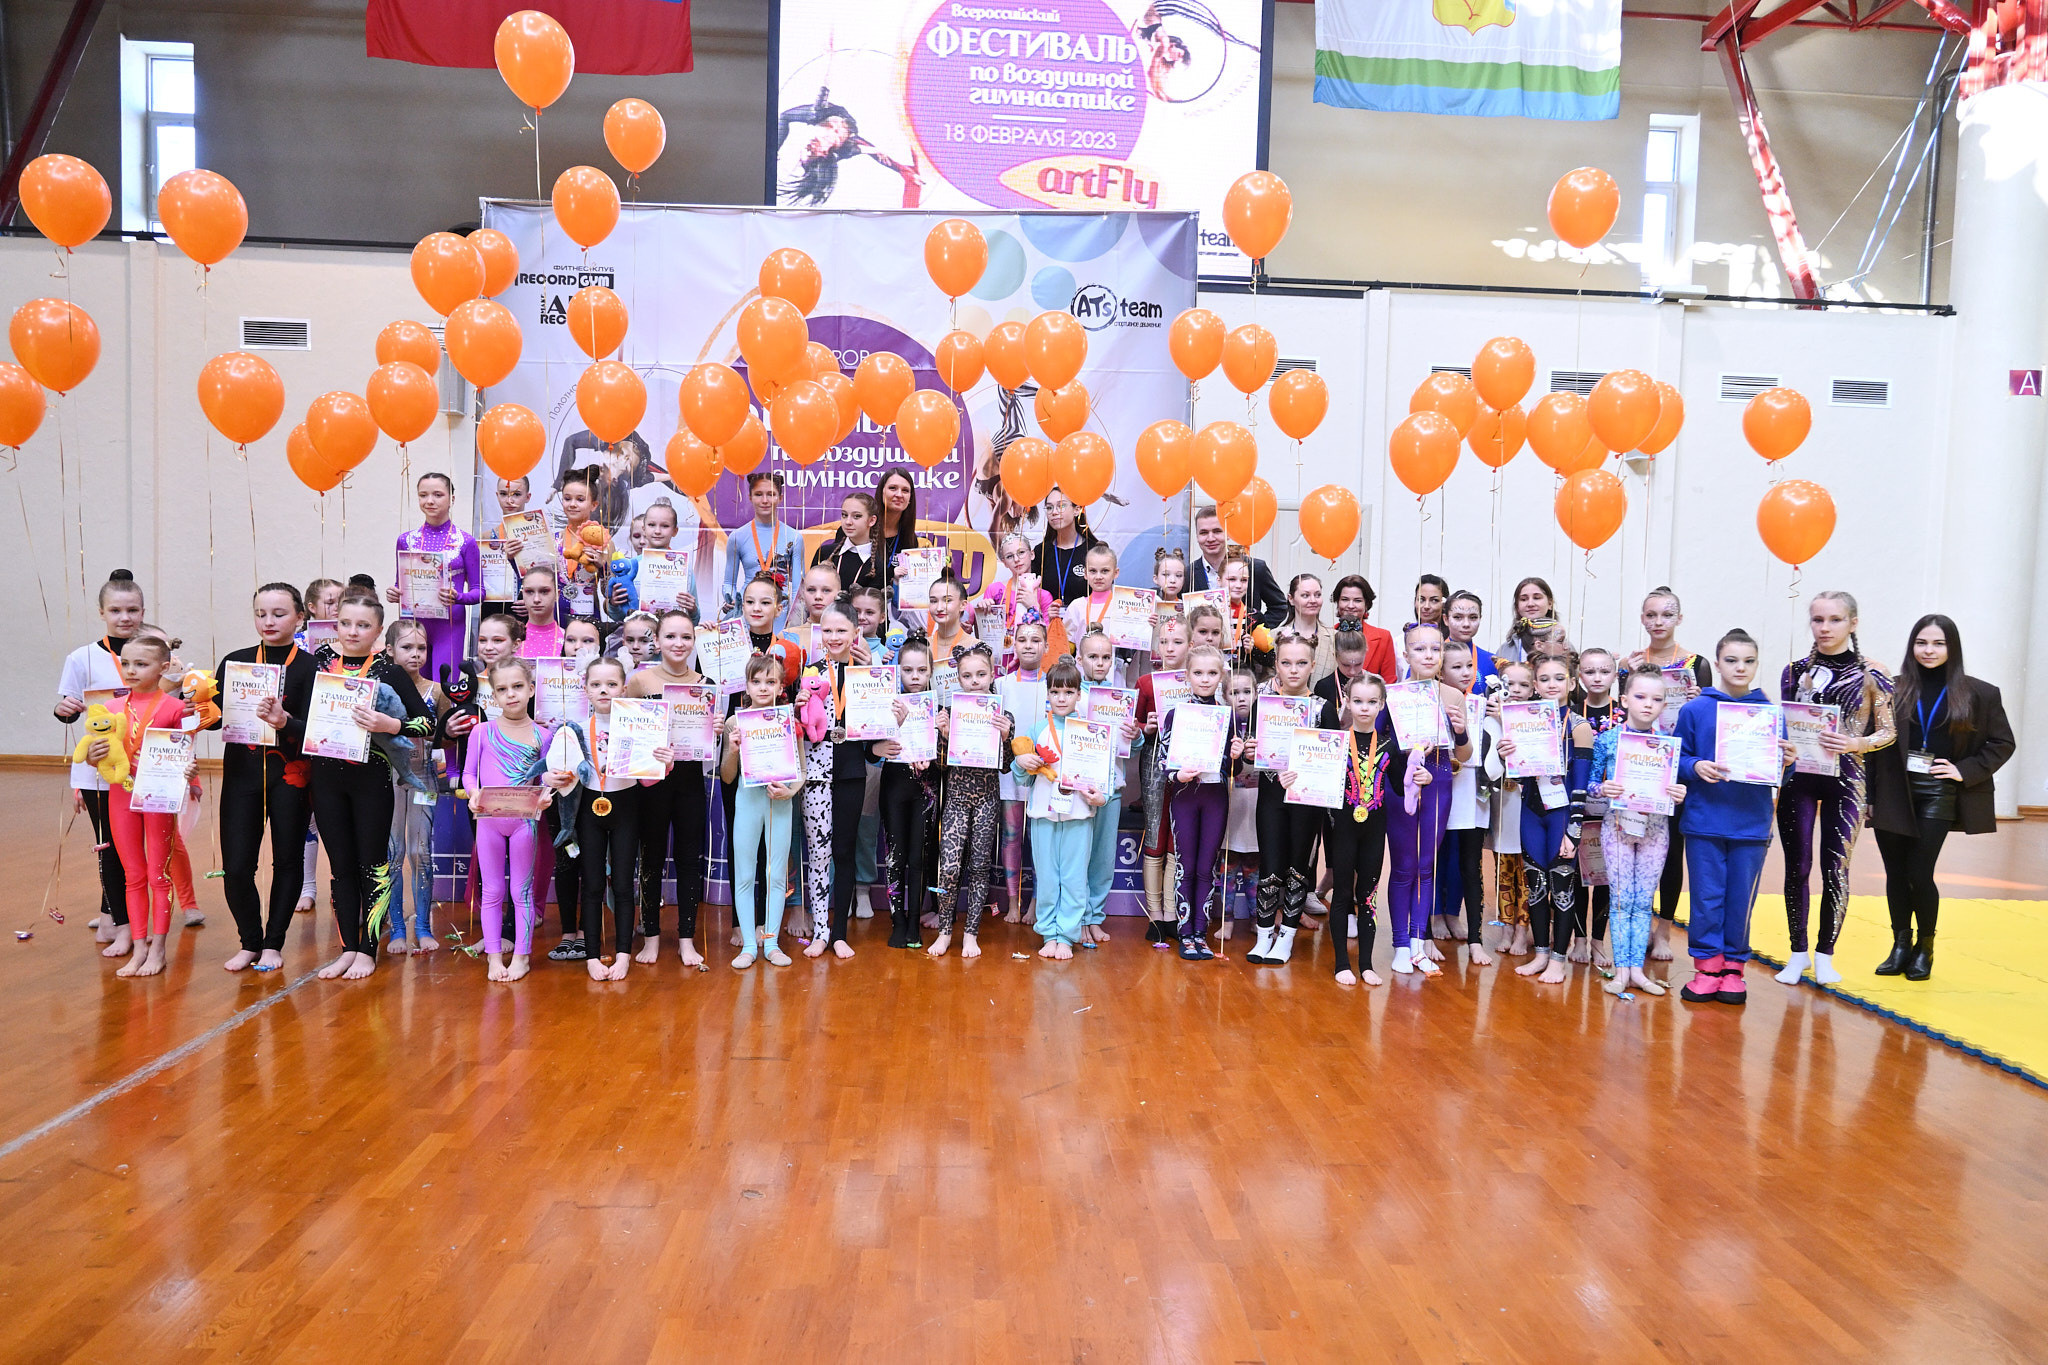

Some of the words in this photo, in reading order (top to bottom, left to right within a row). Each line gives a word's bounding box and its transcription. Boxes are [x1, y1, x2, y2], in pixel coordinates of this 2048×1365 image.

[926, 22, 1138, 64] ФЕСТИВАЛЬ
[970, 65, 999, 83] по
[1003, 62, 1136, 90] воздушной
[969, 87, 1136, 112] гимнастике
[944, 124, 966, 142] 18
[971, 125, 1066, 147] ФЕВРАЛЯ
[1070, 129, 1117, 150] 2023
[1037, 163, 1159, 210] artFly
[519, 273, 577, 286] RECORD
[1120, 298, 1163, 319] team
[521, 533, 529, 541] 2
[655, 570, 662, 579] 2
[1124, 606, 1130, 615] 3
[720, 641, 745, 651] МЕСТО
[231, 681, 266, 690] ГРАМОТА
[944, 680, 950, 689] 2
[240, 688, 248, 700] 3
[330, 700, 336, 713] 1
[482, 700, 488, 710] 3
[673, 703, 706, 712] ИПЛОМ
[629, 723, 633, 733] 1
[1077, 742, 1084, 751] 3
[1083, 742, 1107, 751] МЕСТО
[1298, 745, 1331, 753] ГРАМОТА
[154, 754, 162, 765] 2
[164, 754, 189, 762] МЕСТО
[1305, 752, 1313, 762] 2
[1314, 752, 1340, 760] МЕСТО
[1119, 837, 1137, 865] 3
